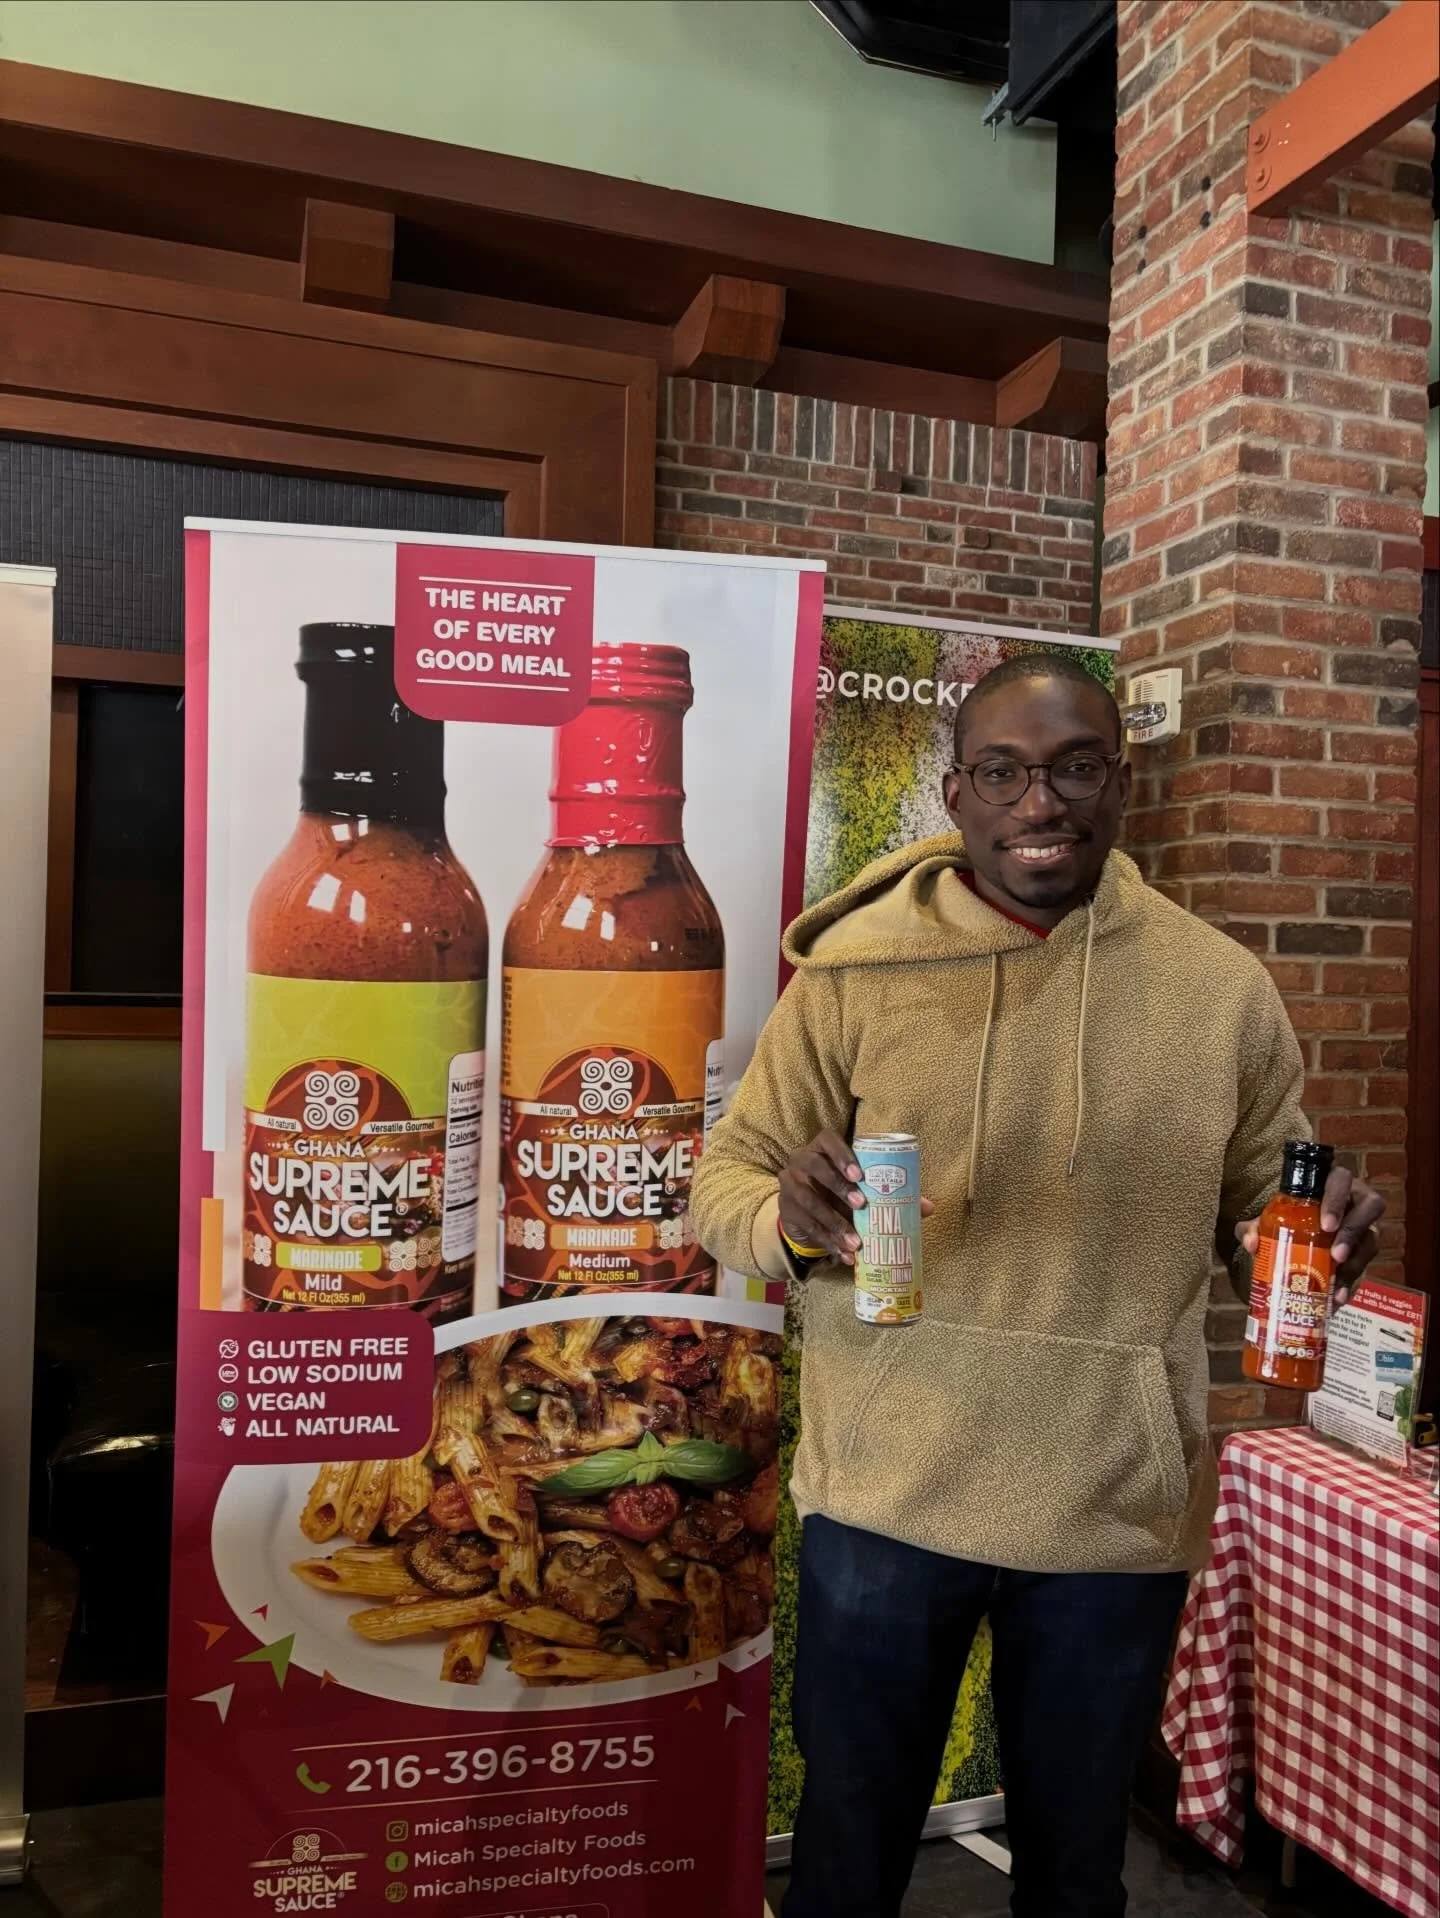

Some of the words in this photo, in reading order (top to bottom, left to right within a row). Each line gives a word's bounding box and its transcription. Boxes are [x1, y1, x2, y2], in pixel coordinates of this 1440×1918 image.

[424, 587, 476, 610] THE
[482, 591, 566, 616] HEART
[433, 618, 470, 640] OF
[476, 621, 556, 646] EVERY
[416, 648, 494, 672] GOOD
[501, 653, 571, 678] MEAL
[1132, 727, 1154, 740] FIRE
[549, 1104, 572, 1115] natural
[642, 1105, 671, 1116] Versatile
[275, 1119, 297, 1129] natural
[370, 1122, 403, 1133] Versatile
[405, 1120, 435, 1132] Gourmet
[569, 1123, 639, 1141] GHANA
[293, 1138, 366, 1158] GHANA
[517, 1138, 694, 1182] SUPREME
[250, 1151, 433, 1201] SUPREME
[567, 1227, 637, 1247] MARINADE
[290, 1247, 363, 1269] MARINADE
[569, 1253, 631, 1268] Medium
[863, 1236, 912, 1265] COLADA
[305, 1273, 342, 1291] Mild
[574, 1270, 584, 1280] 12
[282, 1288, 296, 1300] Net
[298, 1291, 306, 1302] 12
[1364, 1288, 1381, 1300] fruits
[248, 1339, 342, 1359] GLUTEN
[350, 1337, 409, 1357] FREE
[248, 1365, 300, 1384] LOW
[306, 1362, 403, 1384] SODIUM
[246, 1391, 326, 1411] VEGAN
[246, 1419, 288, 1437] ALL
[296, 1414, 400, 1436] NATURAL
[346, 1735, 655, 1792] 216-396-8755
[414, 1800, 629, 1837] micahspecialtyfoods
[414, 1848, 475, 1868] Micah
[482, 1838, 577, 1862] Specialty
[584, 1830, 647, 1850] Foods
[286, 1864, 323, 1876] GHANA
[414, 1856, 695, 1899] micahspecialtyfoods.com
[253, 1871, 357, 1898] SUPREME
